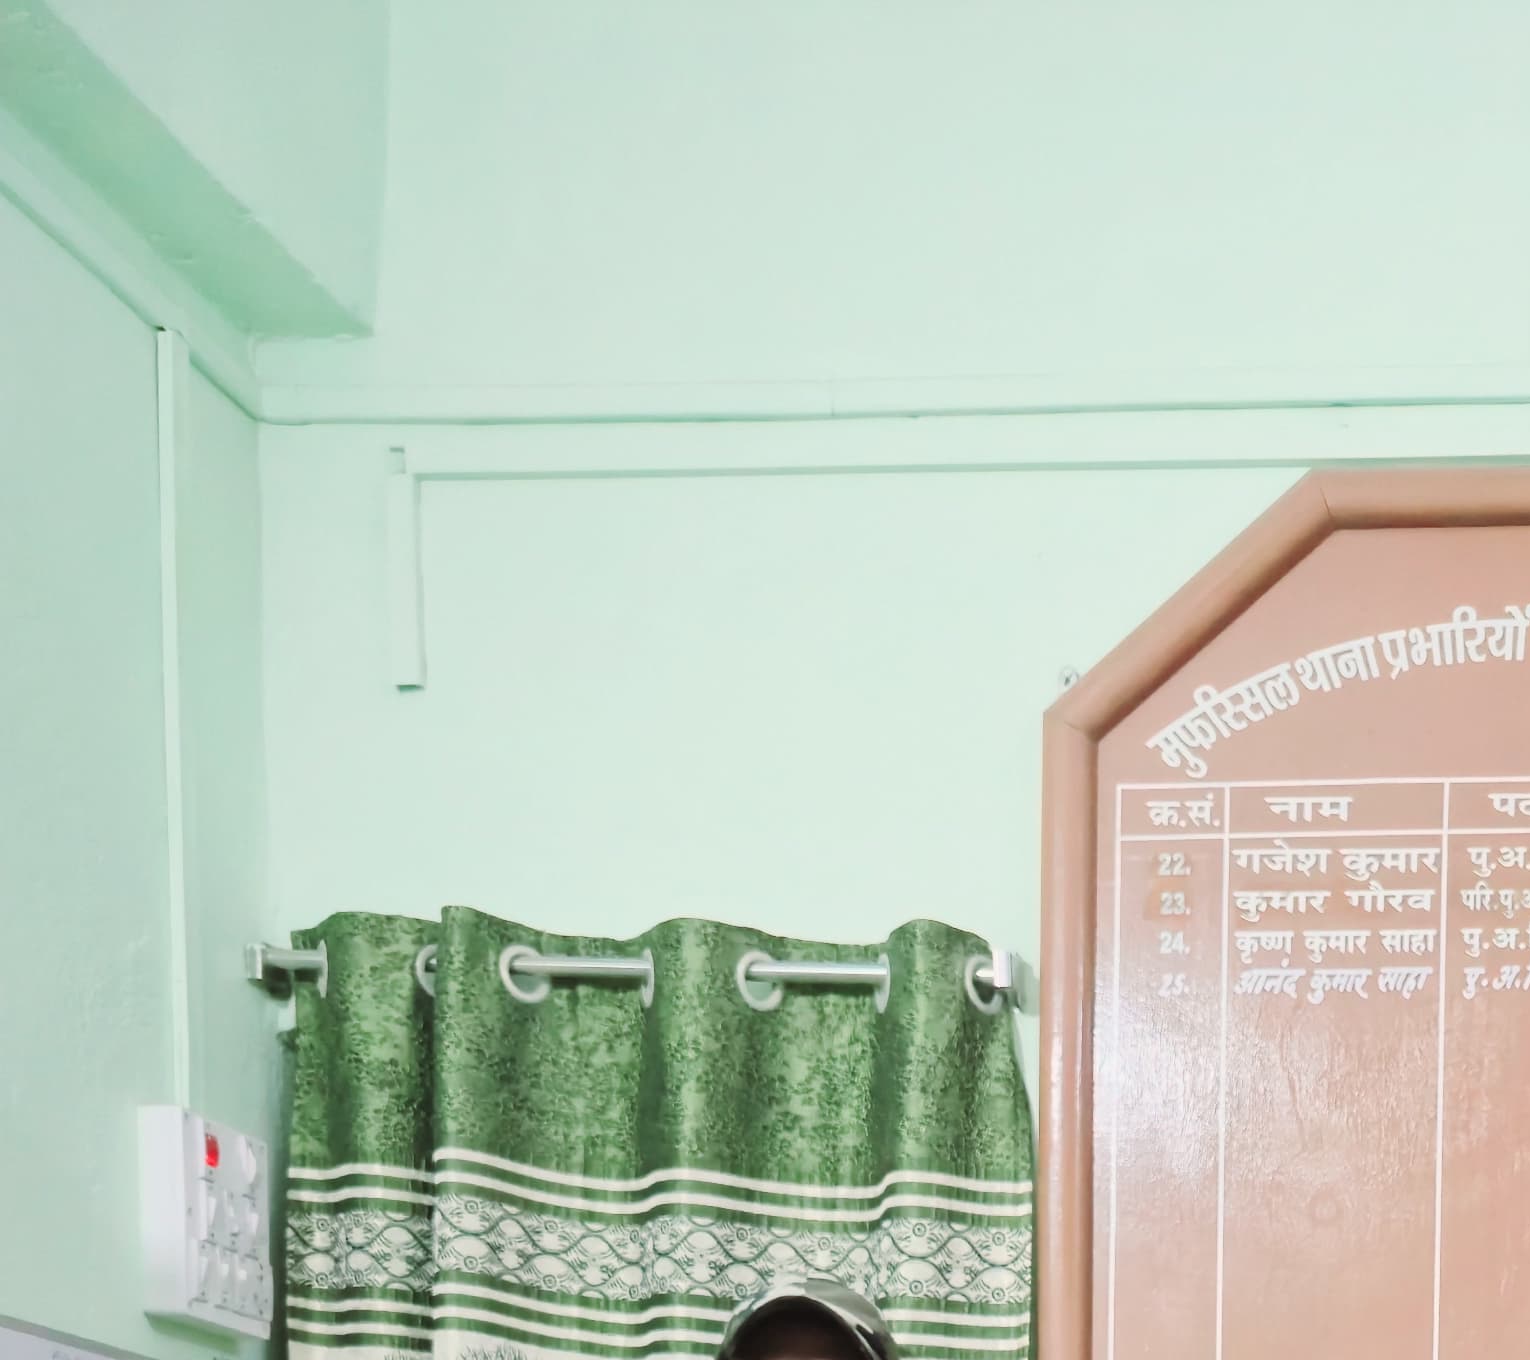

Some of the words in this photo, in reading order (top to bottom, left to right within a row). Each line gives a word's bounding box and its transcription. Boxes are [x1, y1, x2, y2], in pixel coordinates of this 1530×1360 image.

[1295, 636, 1380, 692] थाना
[1264, 796, 1353, 822] नाम
[1339, 847, 1441, 881] कुमार
[1233, 891, 1332, 922] कुमार
[1344, 880, 1436, 913] गौरव
[1234, 930, 1294, 964] कृष्ण
[1303, 930, 1371, 963] कुमार
[1378, 928, 1437, 956] साहा
[1236, 958, 1306, 998] आनंद
[1307, 968, 1372, 1004] कुमार
[1378, 966, 1433, 999] साहा
